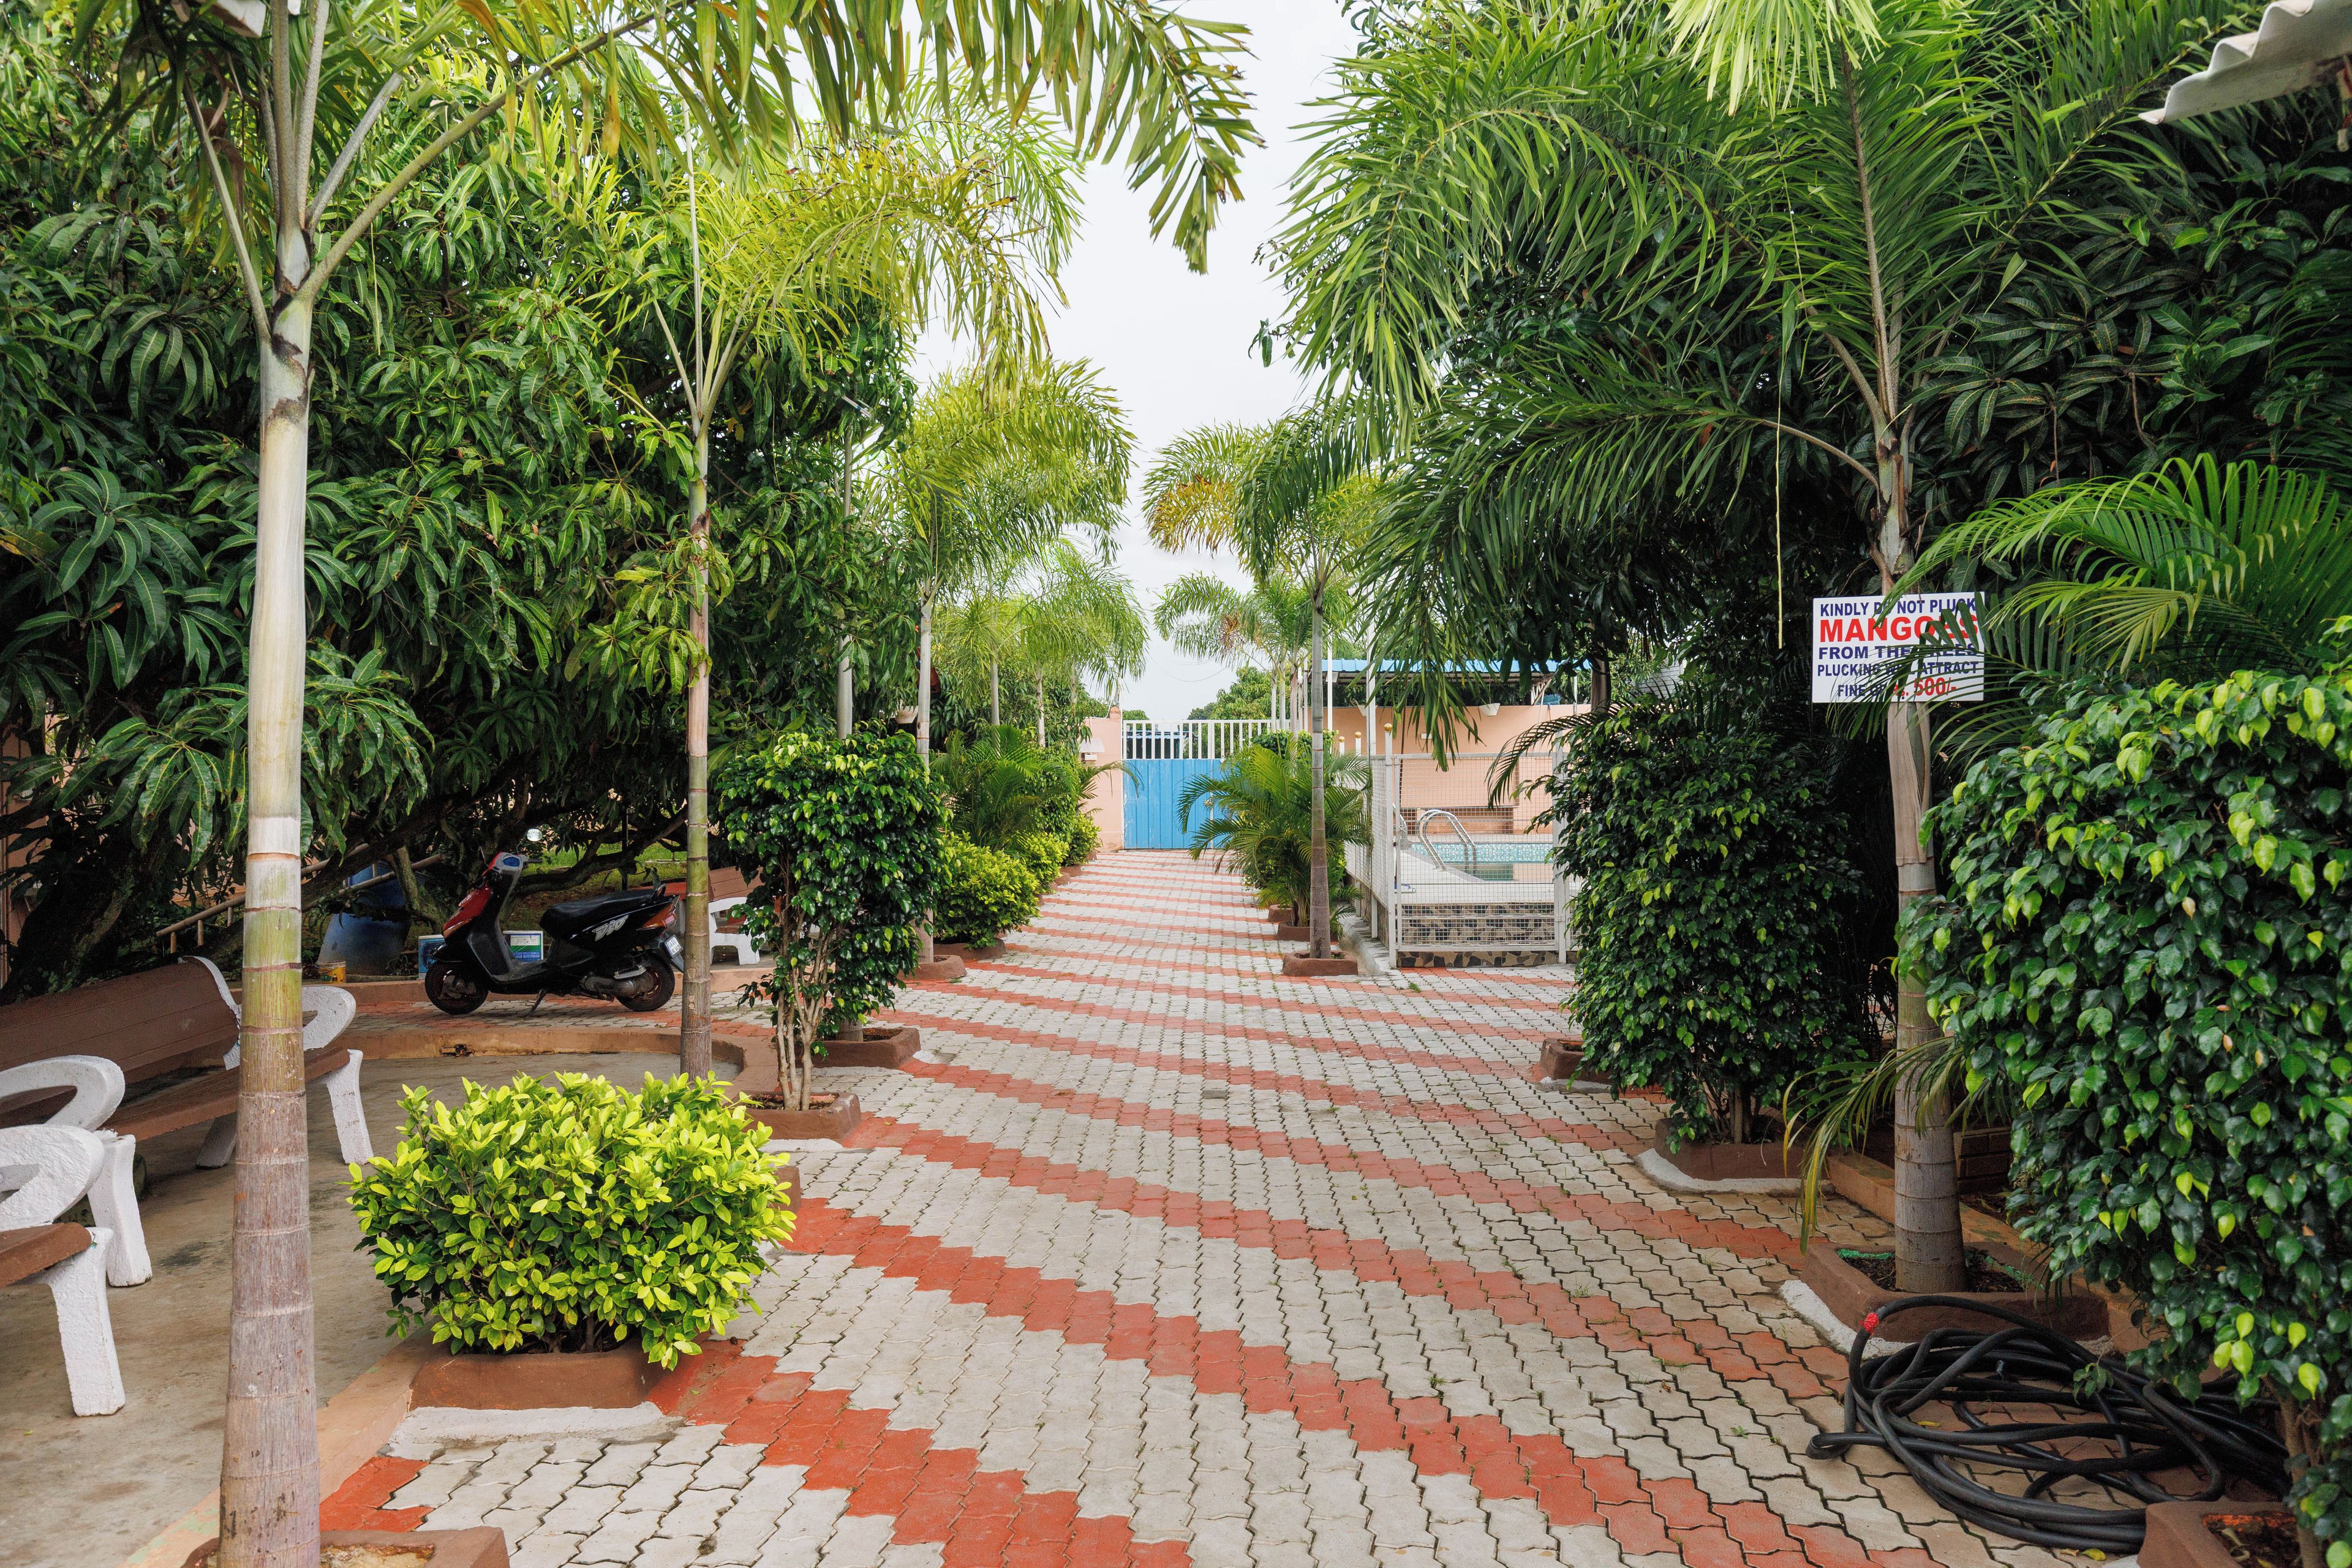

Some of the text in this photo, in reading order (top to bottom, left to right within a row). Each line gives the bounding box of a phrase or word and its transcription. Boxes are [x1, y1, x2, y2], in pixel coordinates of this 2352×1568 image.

[1820, 602, 1869, 617] KINDLY
[1897, 600, 1925, 614] NOT
[1930, 598, 1977, 613] PLUK
[1819, 646, 1868, 660] FROM
[1874, 645, 1911, 659] THE
[1920, 662, 1978, 675] ATTRACT
[1838, 684, 1866, 697] FINE
[1913, 677, 1957, 696] 500/-
